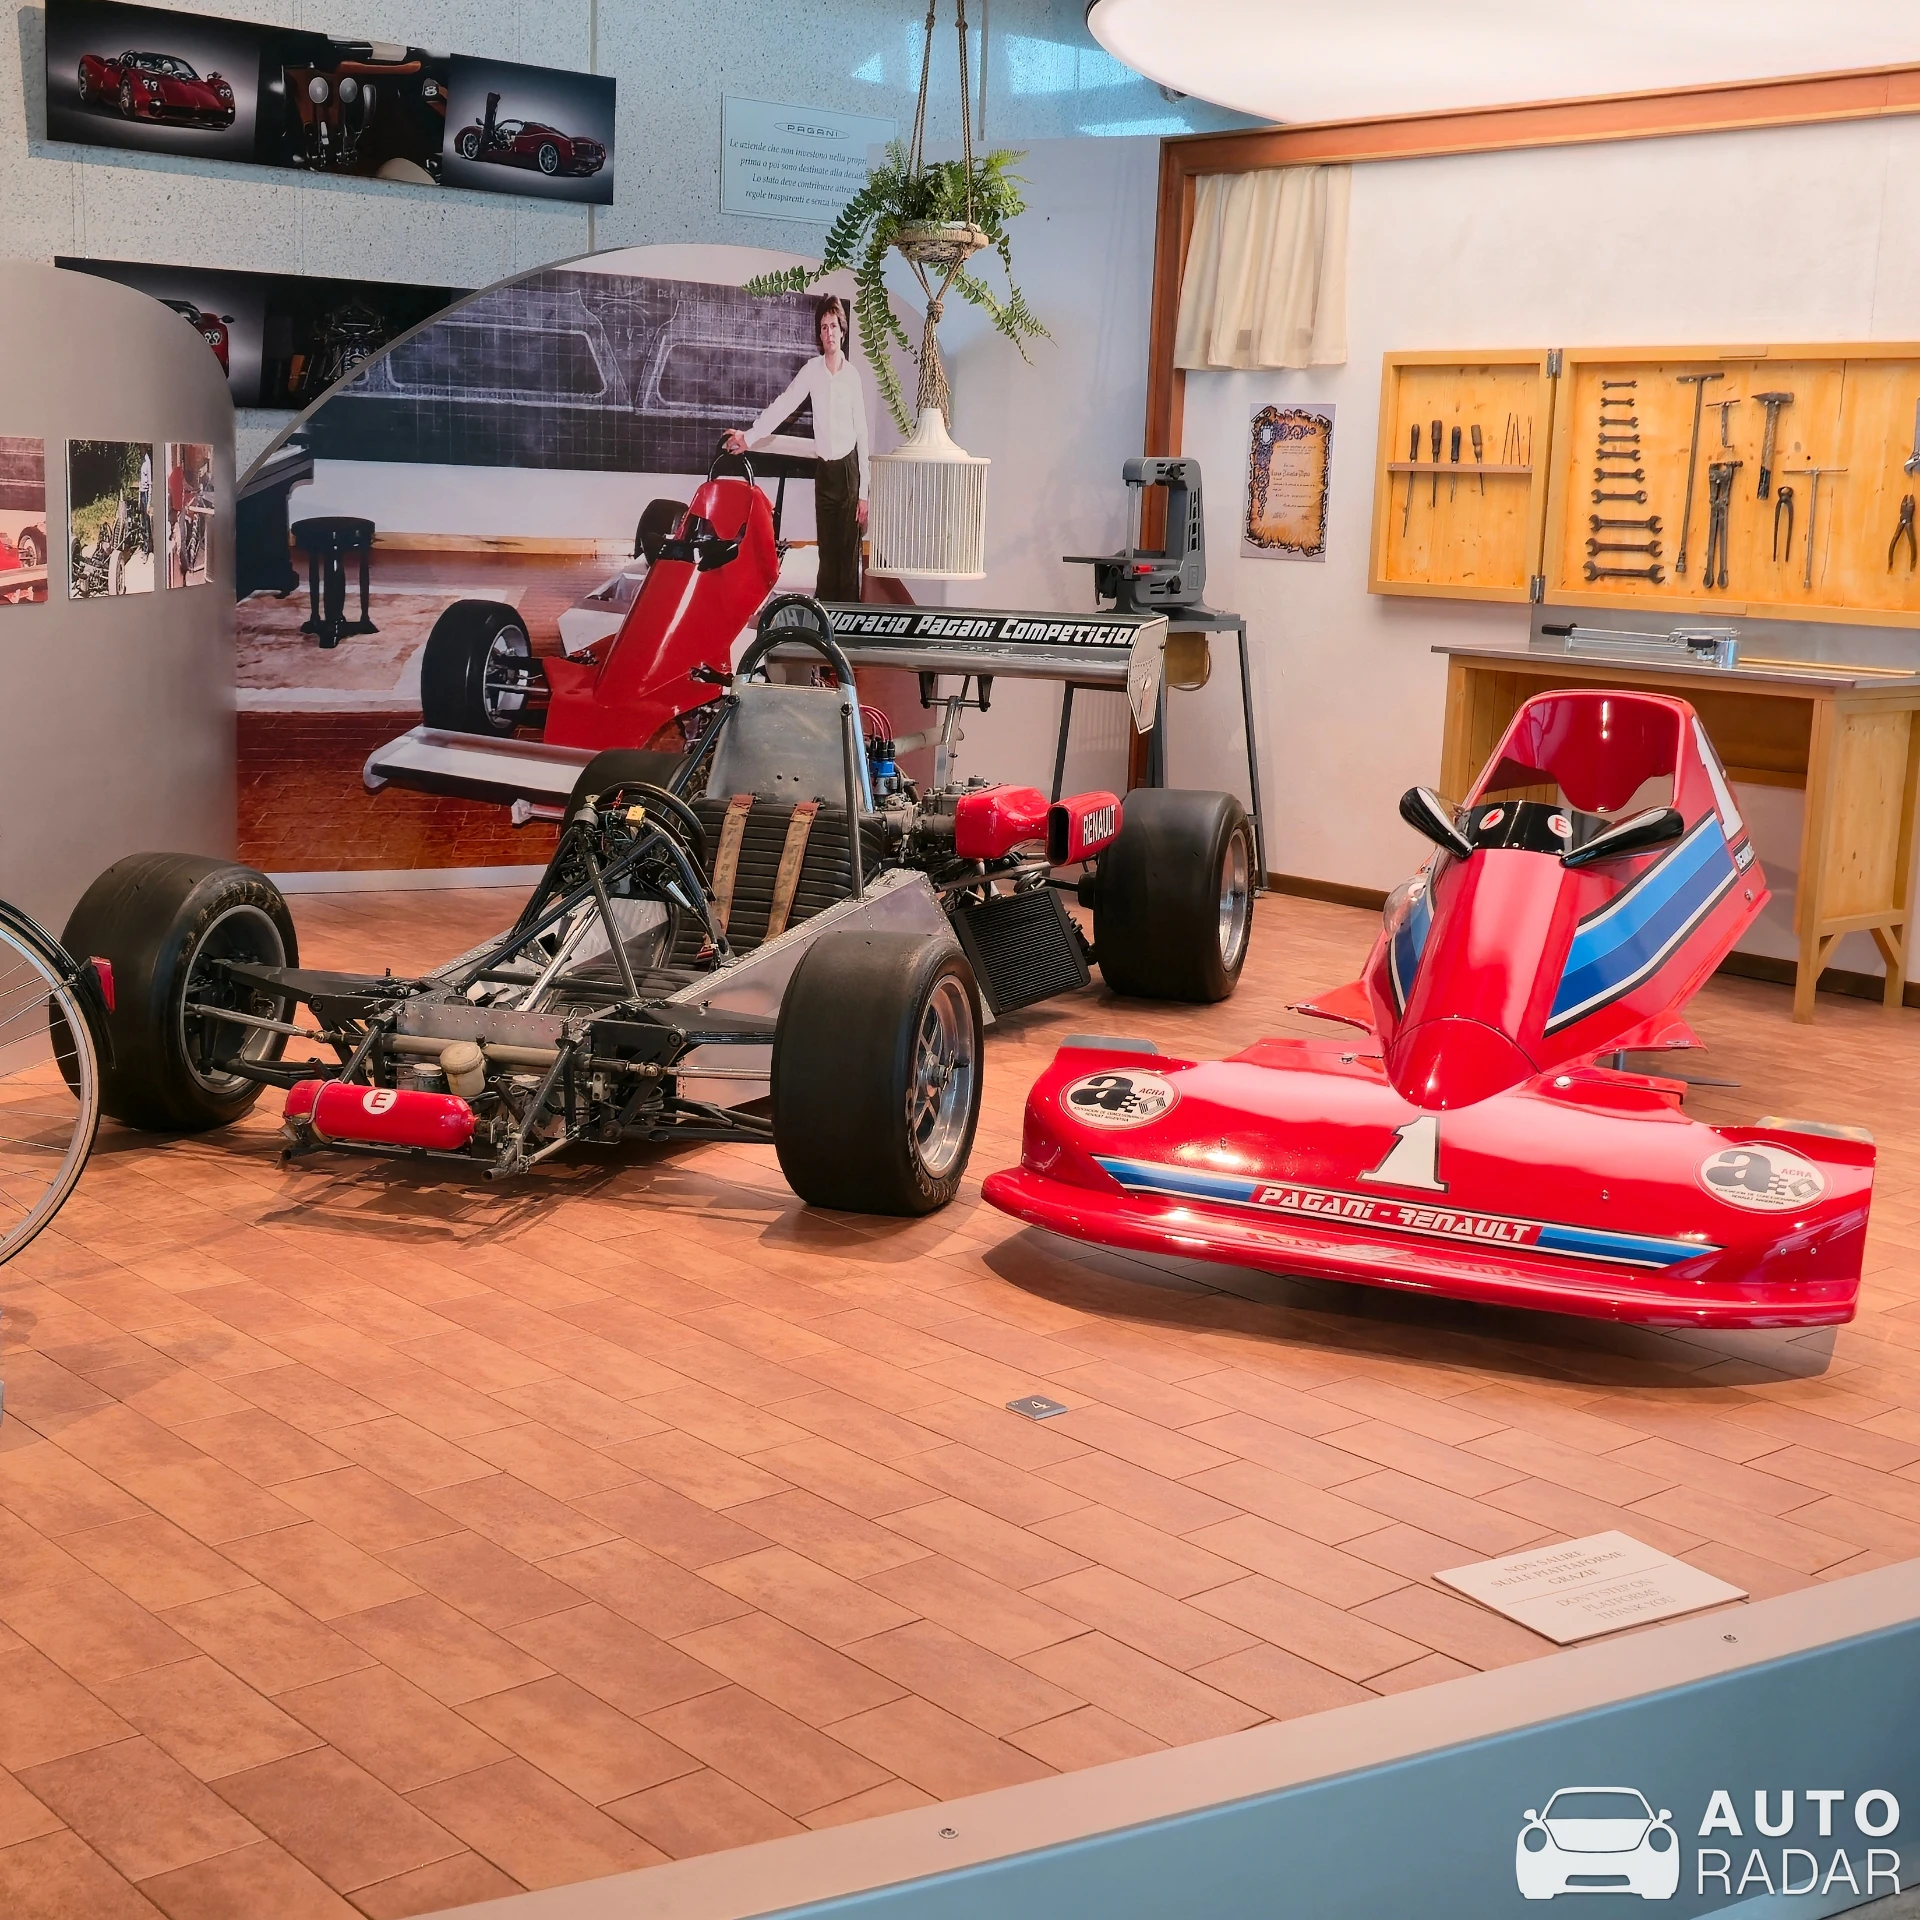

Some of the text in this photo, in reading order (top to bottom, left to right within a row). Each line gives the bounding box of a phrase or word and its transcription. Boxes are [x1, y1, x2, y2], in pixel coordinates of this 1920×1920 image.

[787, 124, 838, 137] PAGANI
[729, 138, 867, 166] Le aziende che non investono nella propri
[740, 157, 761, 167] prima
[768, 160, 780, 170] poi
[781, 163, 797, 172] sono
[798, 164, 829, 176] destinate
[830, 168, 842, 177] alla
[844, 170, 866, 180] decade
[752, 173, 762, 182] Lo
[762, 175, 780, 184] stato
[780, 177, 797, 187] deve
[798, 181, 834, 192] contribuire
[745, 190, 767, 200] regole
[767, 192, 805, 203] trasparenti
[1082, 804, 1116, 847] RENAULT
[1555, 817, 1567, 834] E
[370, 1091, 391, 1109] E
[1356, 1115, 1449, 1193] 1
[1031, 1400, 1051, 1410] 4
[1490, 1550, 1626, 1588] SULLE PIATTAFORME
[1503, 1550, 1586, 1574] NON SALIRE
[1548, 1568, 1601, 1585] GRAZIE
[1599, 1584, 1629, 1597] STEP
[1630, 1578, 1654, 1588] ON
[1582, 1589, 1660, 1612] PLATFORMS
[1595, 1595, 1677, 1620] THANK YOU
